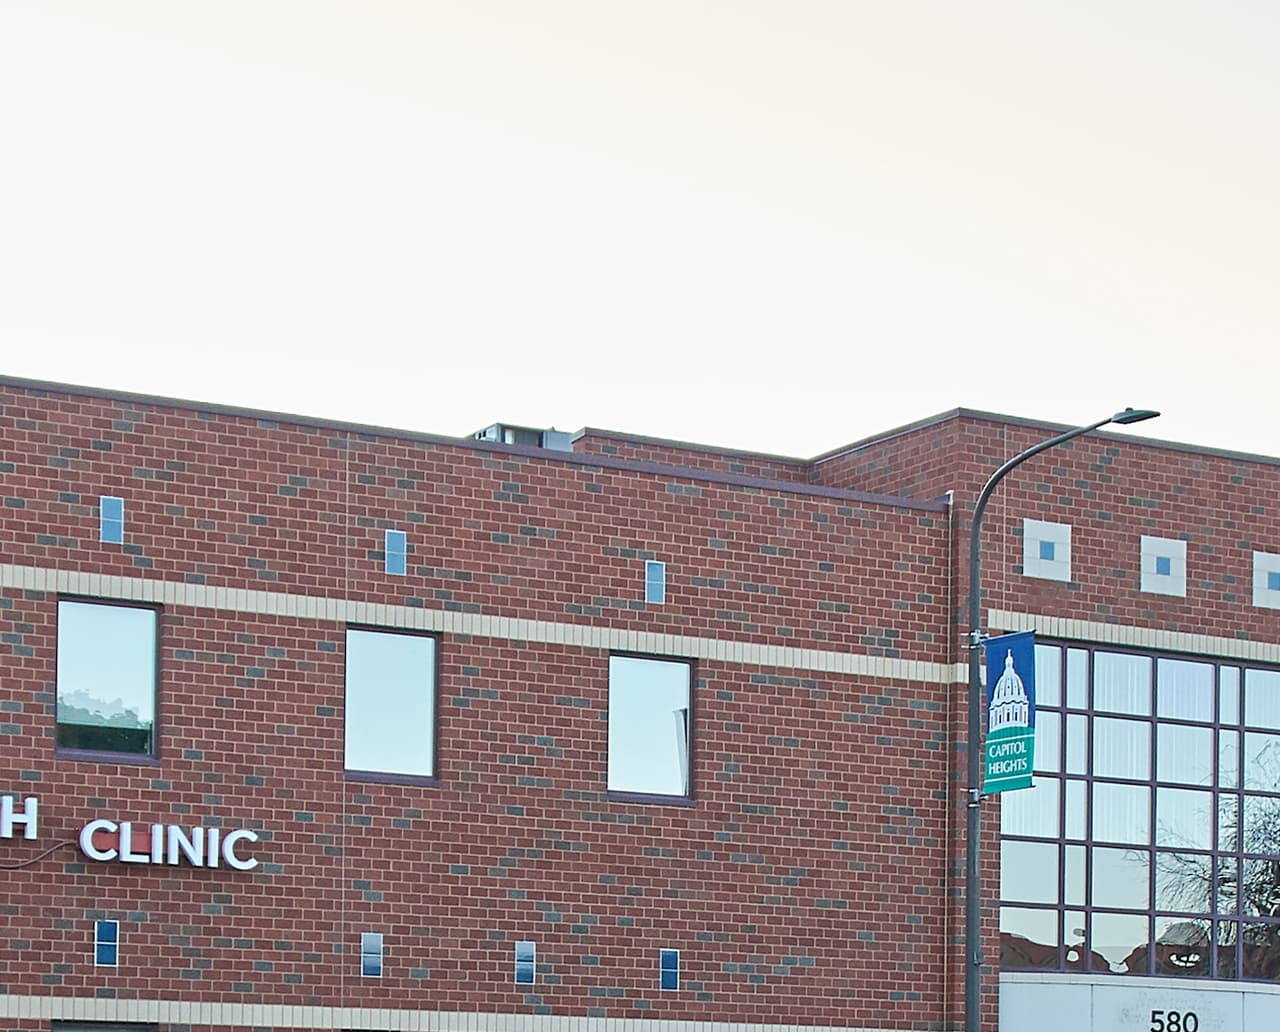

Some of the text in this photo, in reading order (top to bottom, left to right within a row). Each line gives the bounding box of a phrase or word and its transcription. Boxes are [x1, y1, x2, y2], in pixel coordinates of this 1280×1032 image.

[989, 741, 1027, 758] CAPITOL
[988, 758, 1027, 775] HEIGHTS
[79, 818, 260, 871] CLINIC
